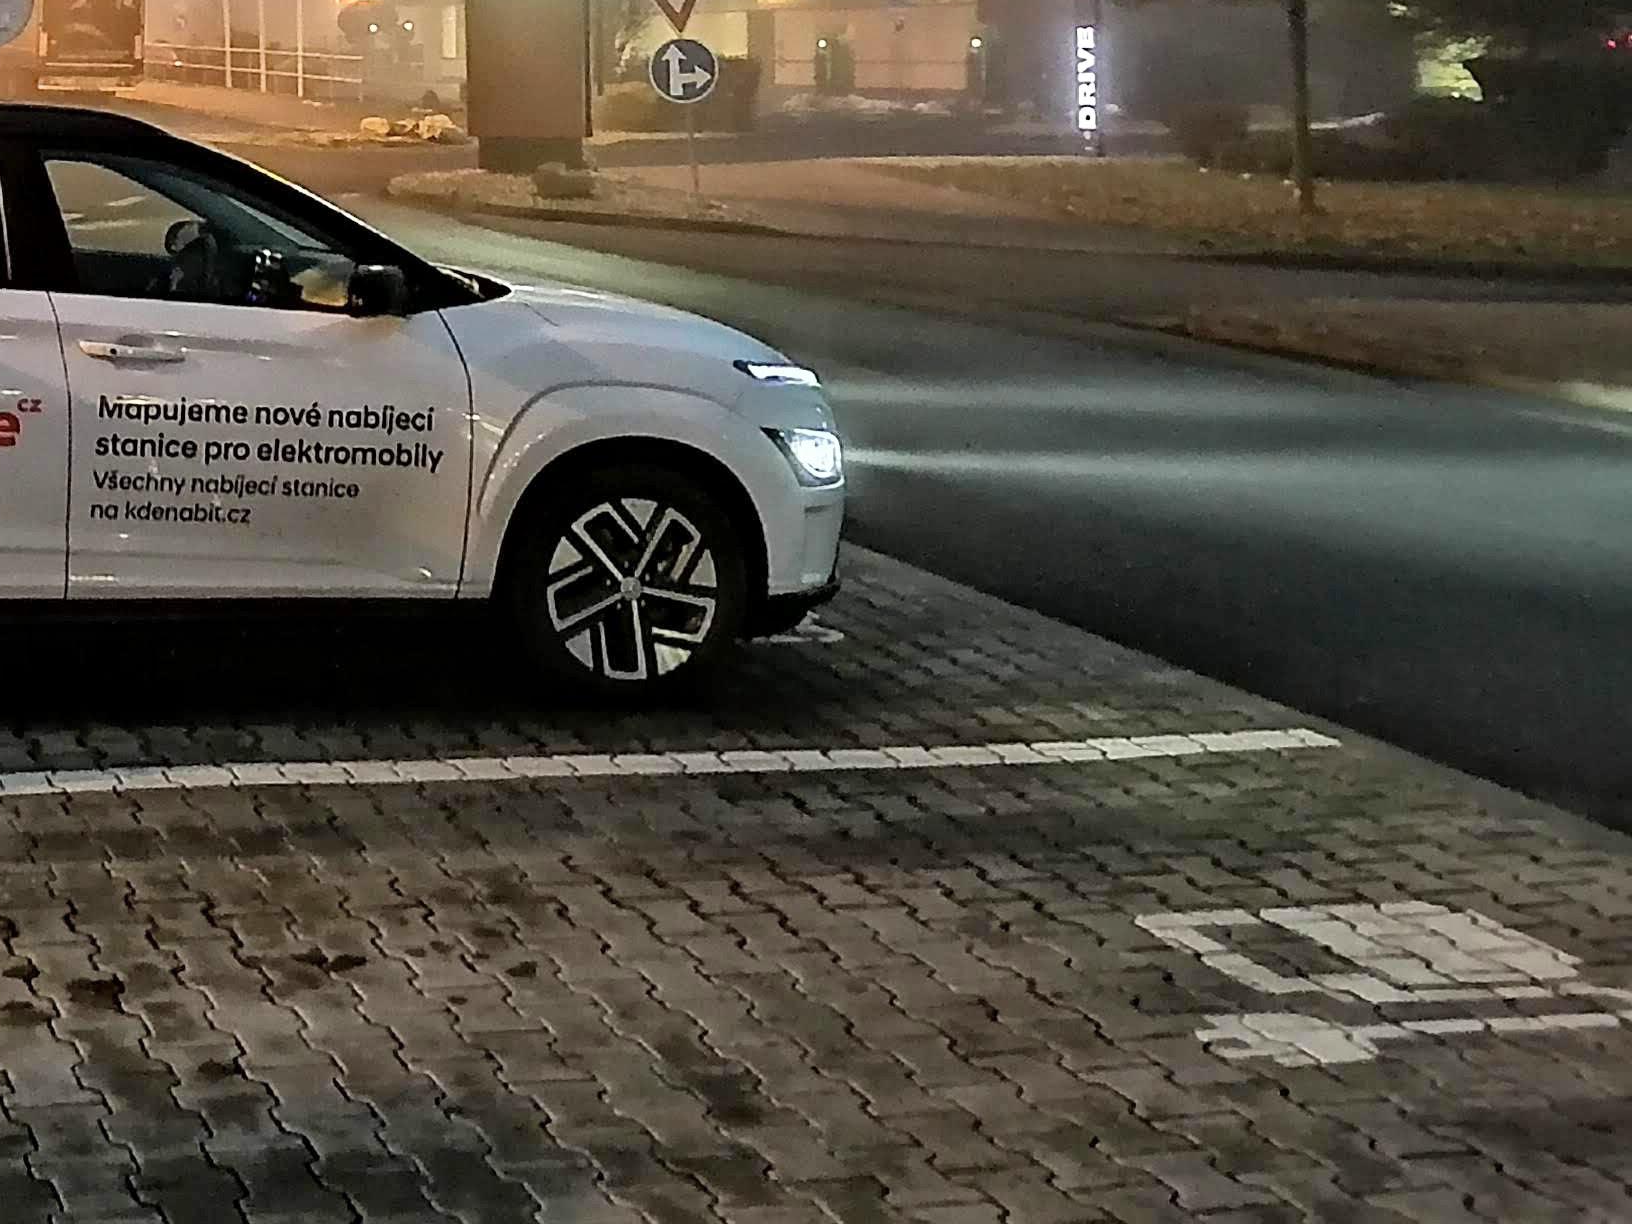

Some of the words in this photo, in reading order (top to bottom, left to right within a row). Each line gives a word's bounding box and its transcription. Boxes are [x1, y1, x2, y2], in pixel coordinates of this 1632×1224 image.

[1076, 26, 1096, 129] DRIVE
[98, 395, 248, 426] Mapujeme
[255, 402, 321, 427] nové
[95, 433, 198, 458] stanice
[204, 440, 250, 465] pro
[257, 438, 444, 473] elektromobily
[93, 470, 185, 496] Všechny
[282, 478, 360, 497] stanice
[90, 504, 118, 519] na
[125, 501, 251, 524] kdenabit.cz
